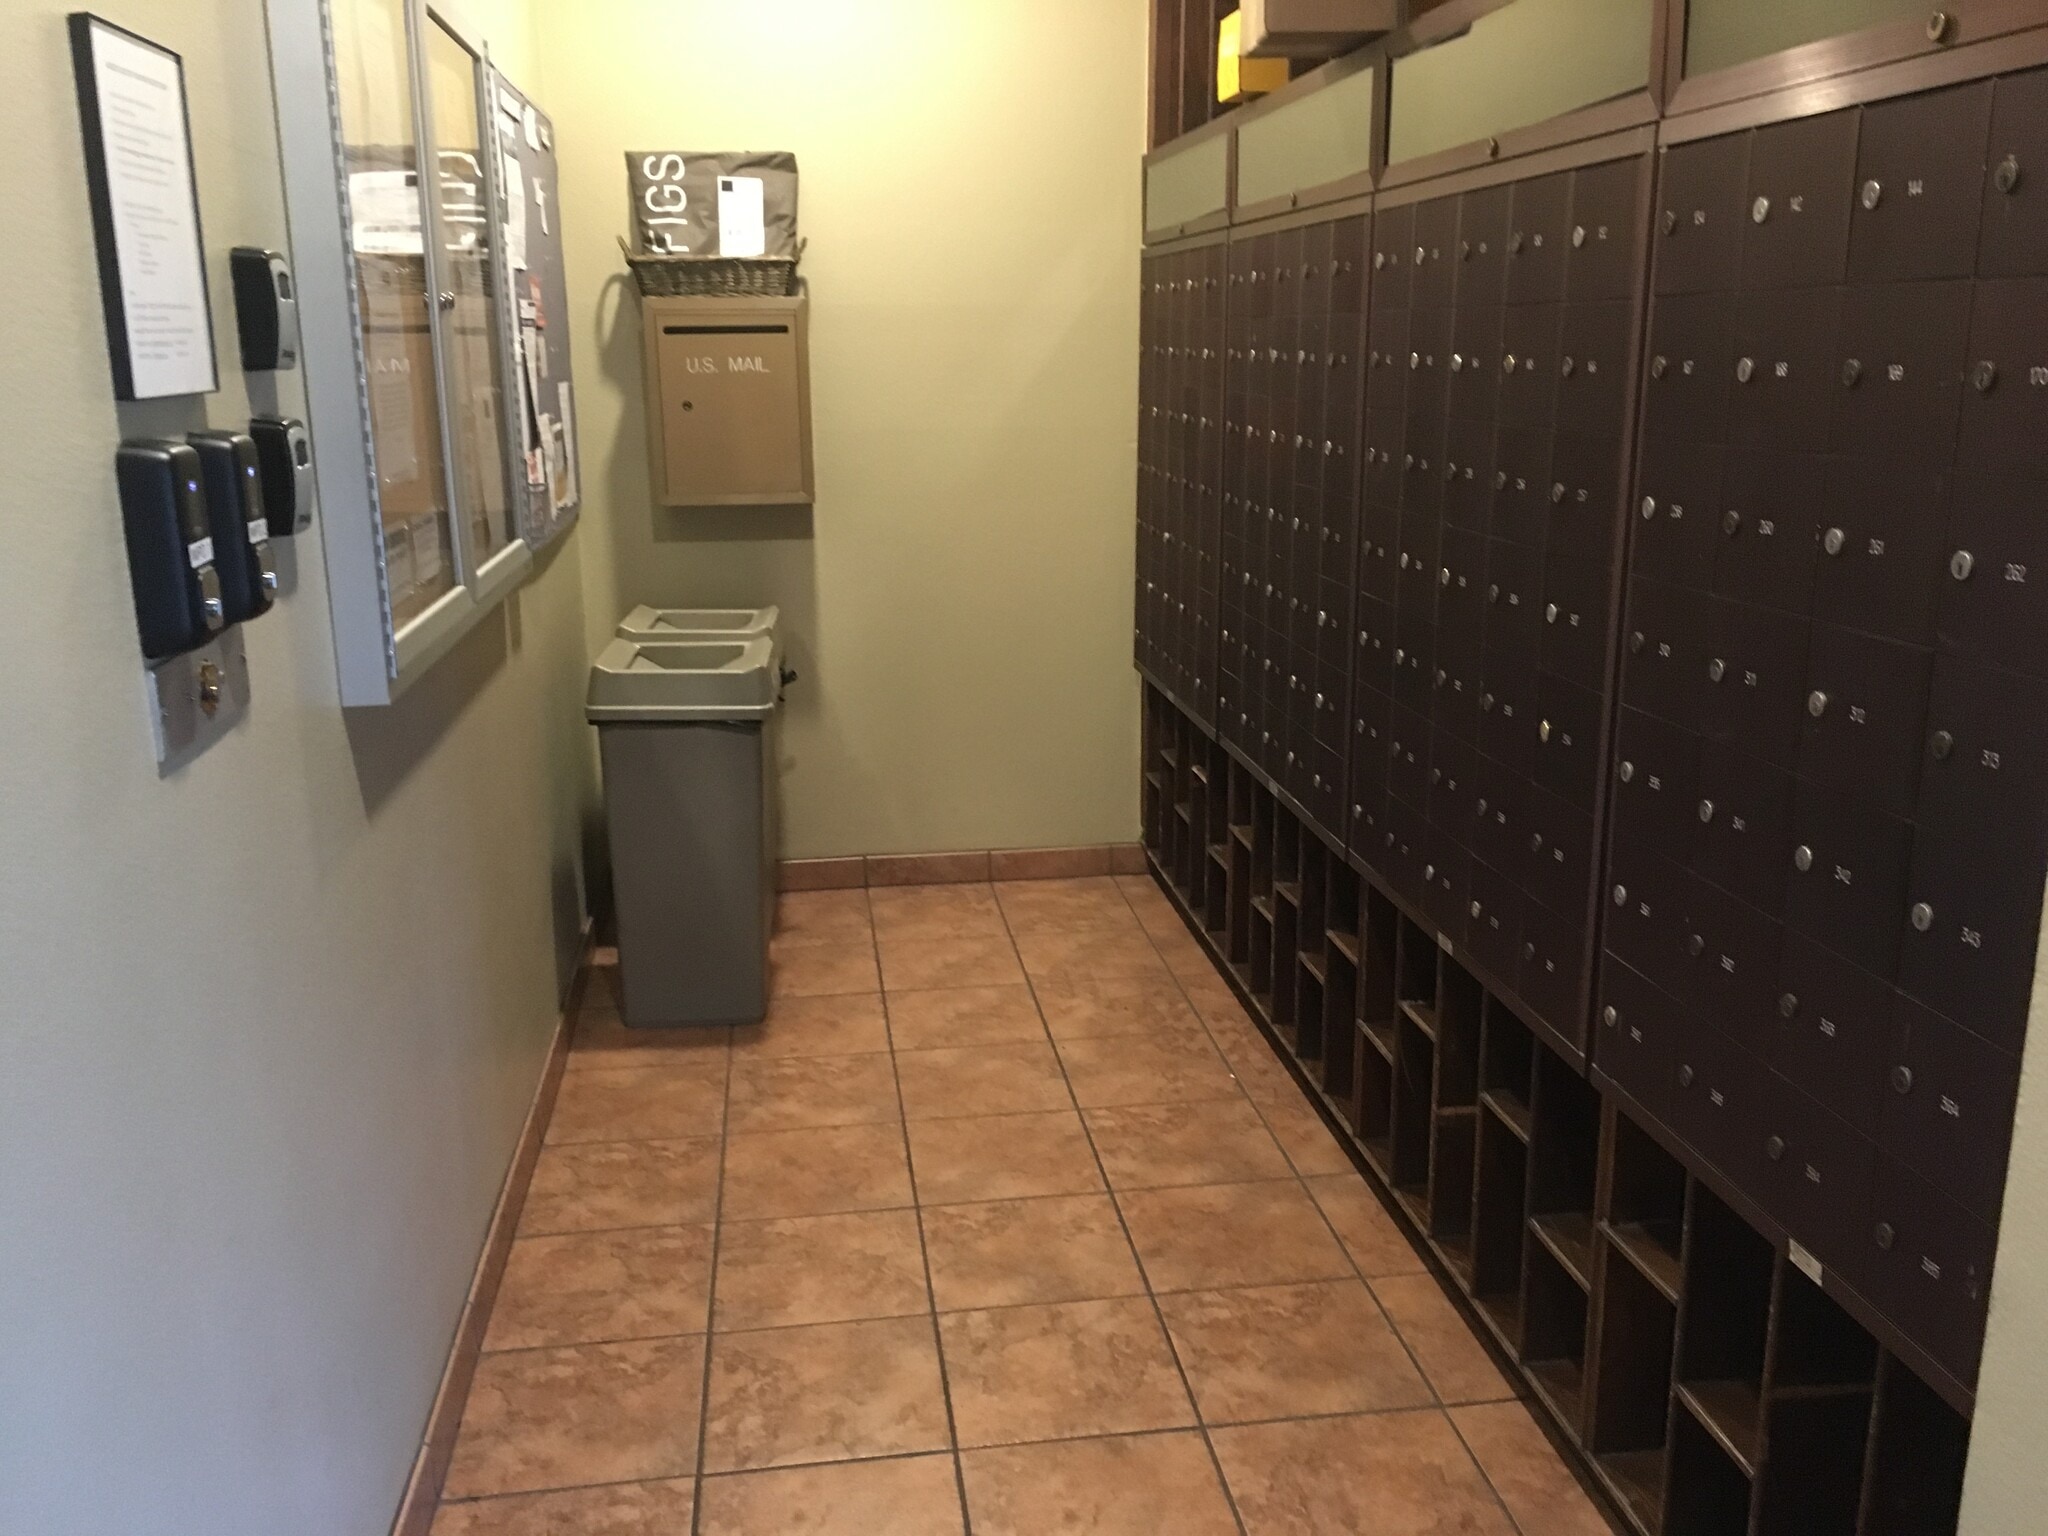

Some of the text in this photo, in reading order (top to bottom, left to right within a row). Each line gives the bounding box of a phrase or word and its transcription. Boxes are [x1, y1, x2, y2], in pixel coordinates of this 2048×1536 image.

[643, 154, 689, 253] FIGS
[686, 356, 770, 374] U.S. MAIL
